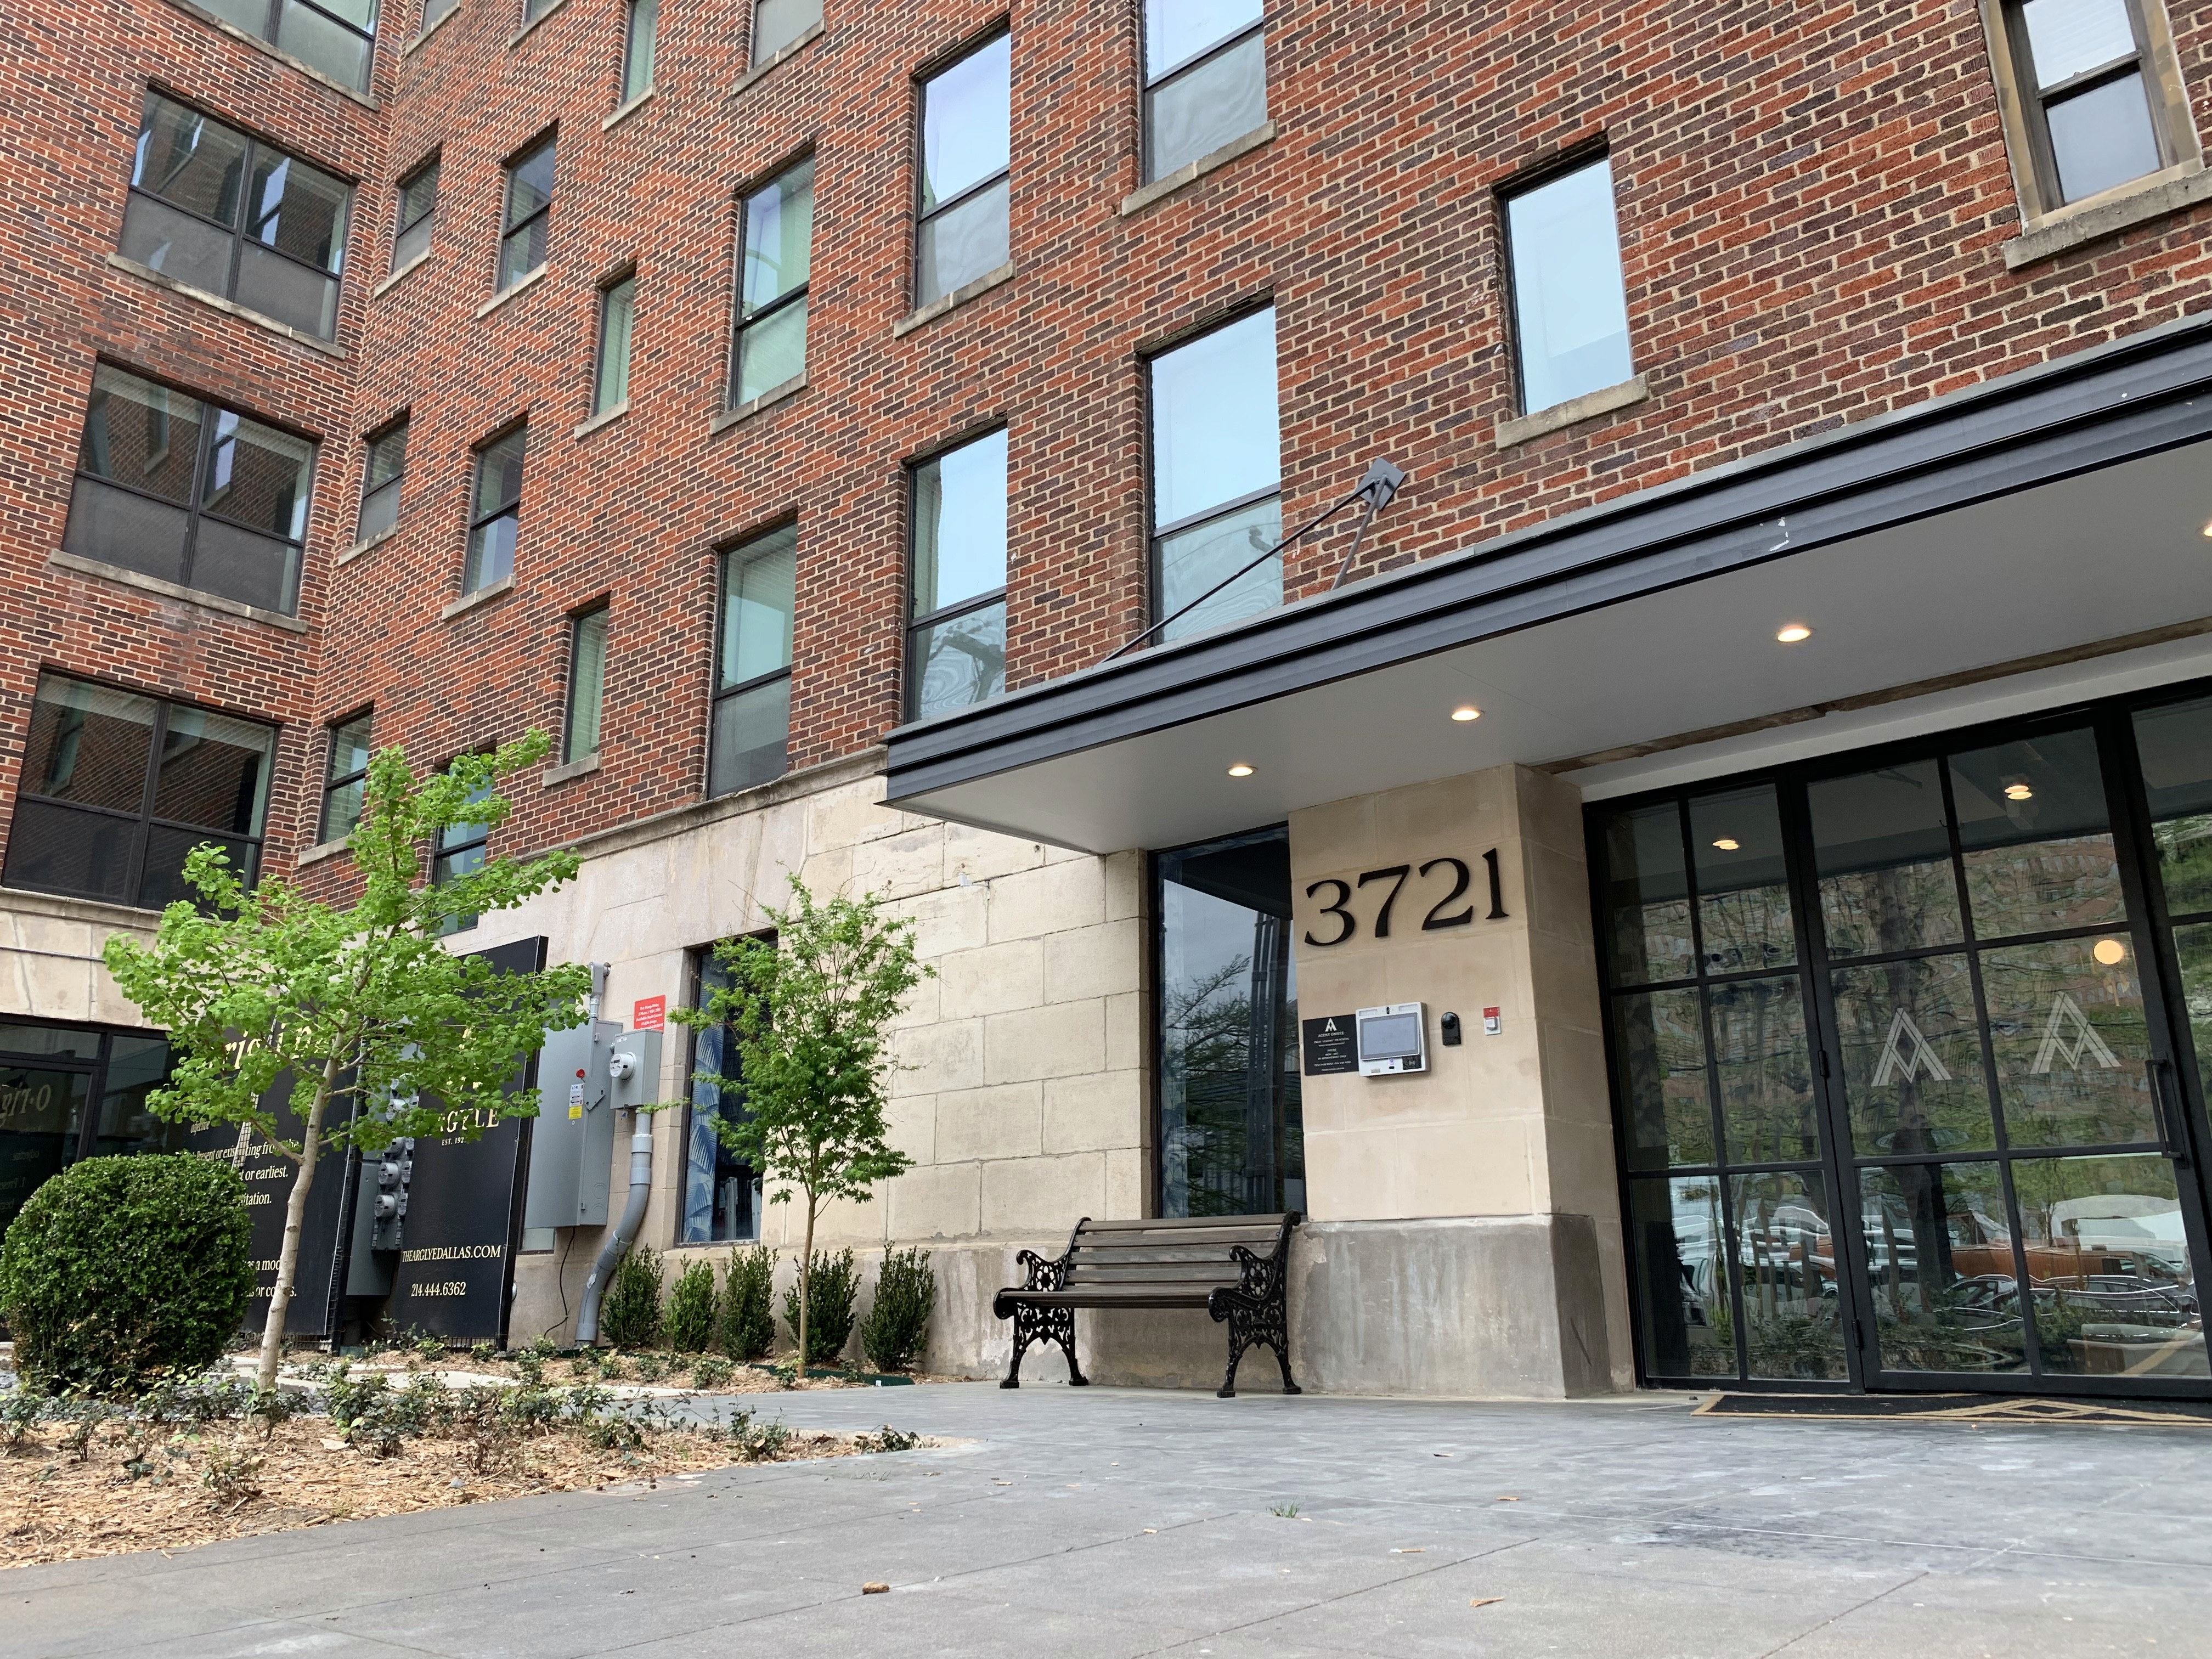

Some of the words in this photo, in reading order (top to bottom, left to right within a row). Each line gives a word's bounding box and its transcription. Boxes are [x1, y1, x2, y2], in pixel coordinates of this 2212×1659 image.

[1305, 848, 1509, 946] 3721
[441, 1138, 453, 1146] EST.
[455, 1136, 466, 1144] 192
[215, 1150, 223, 1159] or
[245, 1170, 255, 1181] or
[256, 1165, 289, 1180] earliest.
[411, 1282, 466, 1297] 214.444.6362
